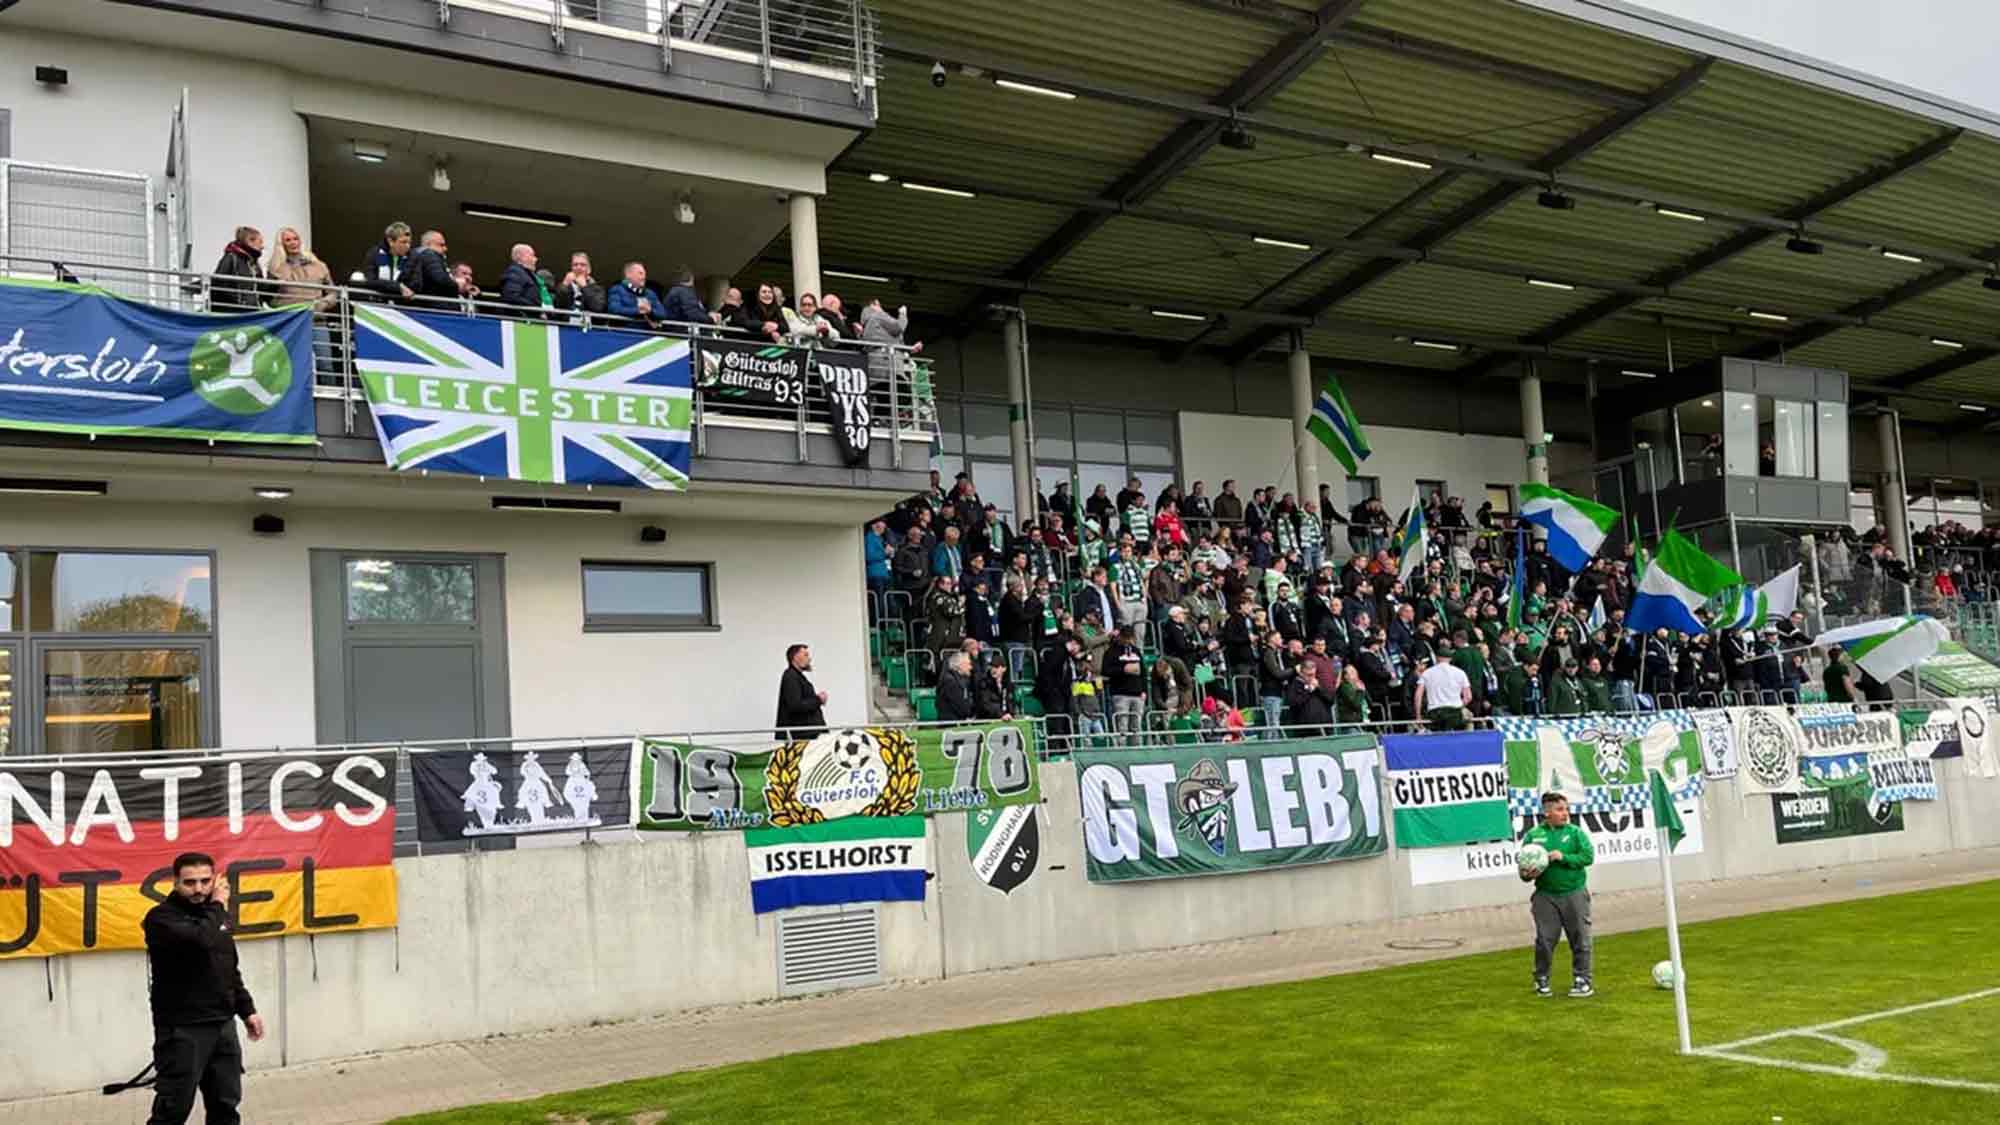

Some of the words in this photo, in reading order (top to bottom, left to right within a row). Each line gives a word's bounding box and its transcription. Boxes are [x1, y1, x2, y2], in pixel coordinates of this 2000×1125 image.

[724, 351, 799, 379] Gütersloh
[383, 375, 671, 427] LEICESTER
[942, 727, 1032, 797] 78
[849, 769, 881, 784] F.C.
[1394, 770, 1507, 805] GÜTERSLOH
[0, 755, 388, 848] NATICS
[476, 789, 488, 805] 3
[573, 785, 585, 799] 2
[800, 785, 879, 805] Gütersloh
[925, 786, 988, 811] Liebe
[1080, 763, 1179, 864] GT
[1227, 749, 1382, 852] LEBT
[1780, 797, 1830, 818] WERDEN
[765, 843, 912, 873] ISSELHORST
[1010, 846, 1032, 873] e.V.
